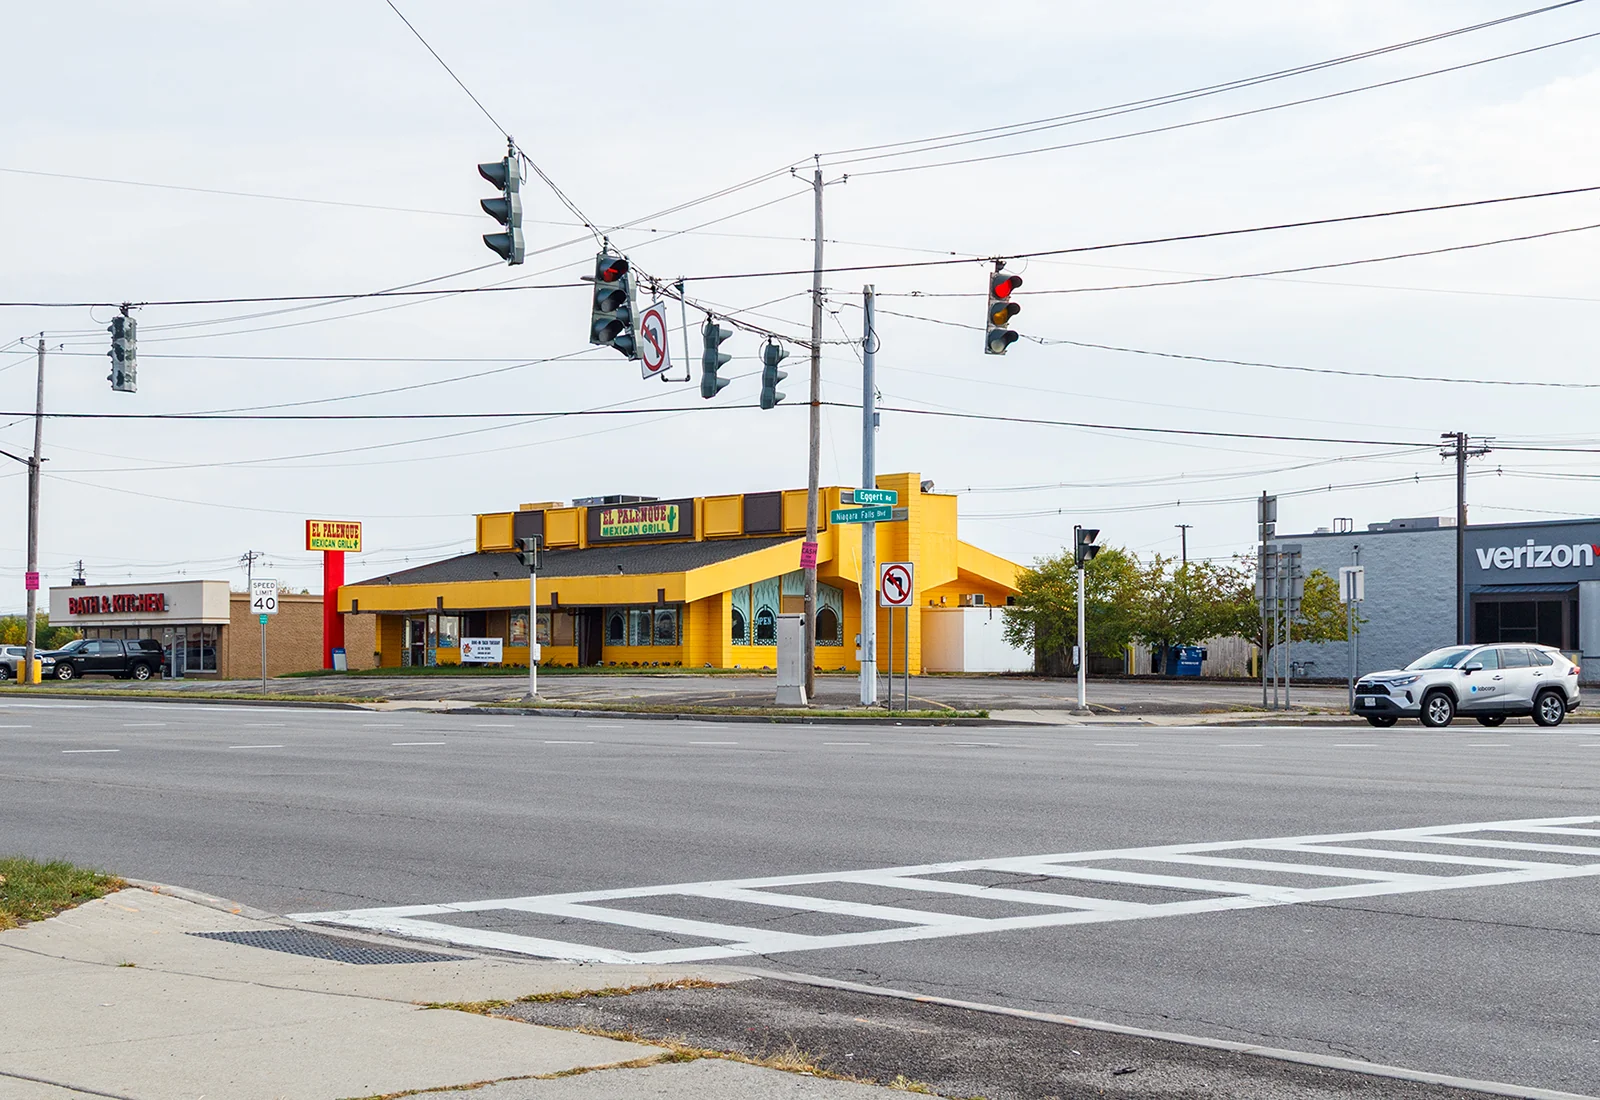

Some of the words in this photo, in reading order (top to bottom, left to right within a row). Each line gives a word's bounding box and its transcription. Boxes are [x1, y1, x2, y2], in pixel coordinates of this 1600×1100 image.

[860, 492, 883, 503] Eggert
[603, 510, 614, 525] EL
[617, 506, 666, 524] PALENQUE
[836, 512, 858, 522] Niagara
[861, 511, 875, 519] Falls
[312, 523, 320, 537] EL
[323, 523, 359, 540] PALENQUE
[603, 526, 639, 536] MEXICAN
[641, 523, 666, 534] GRILL
[312, 538, 335, 548] MEXICAN
[337, 539, 353, 549] GRILL
[1475, 539, 1594, 570] verizon
[69, 596, 100, 615] BATH
[102, 595, 112, 613] &
[112, 593, 165, 613] KITCHEN
[253, 597, 276, 610] 40
